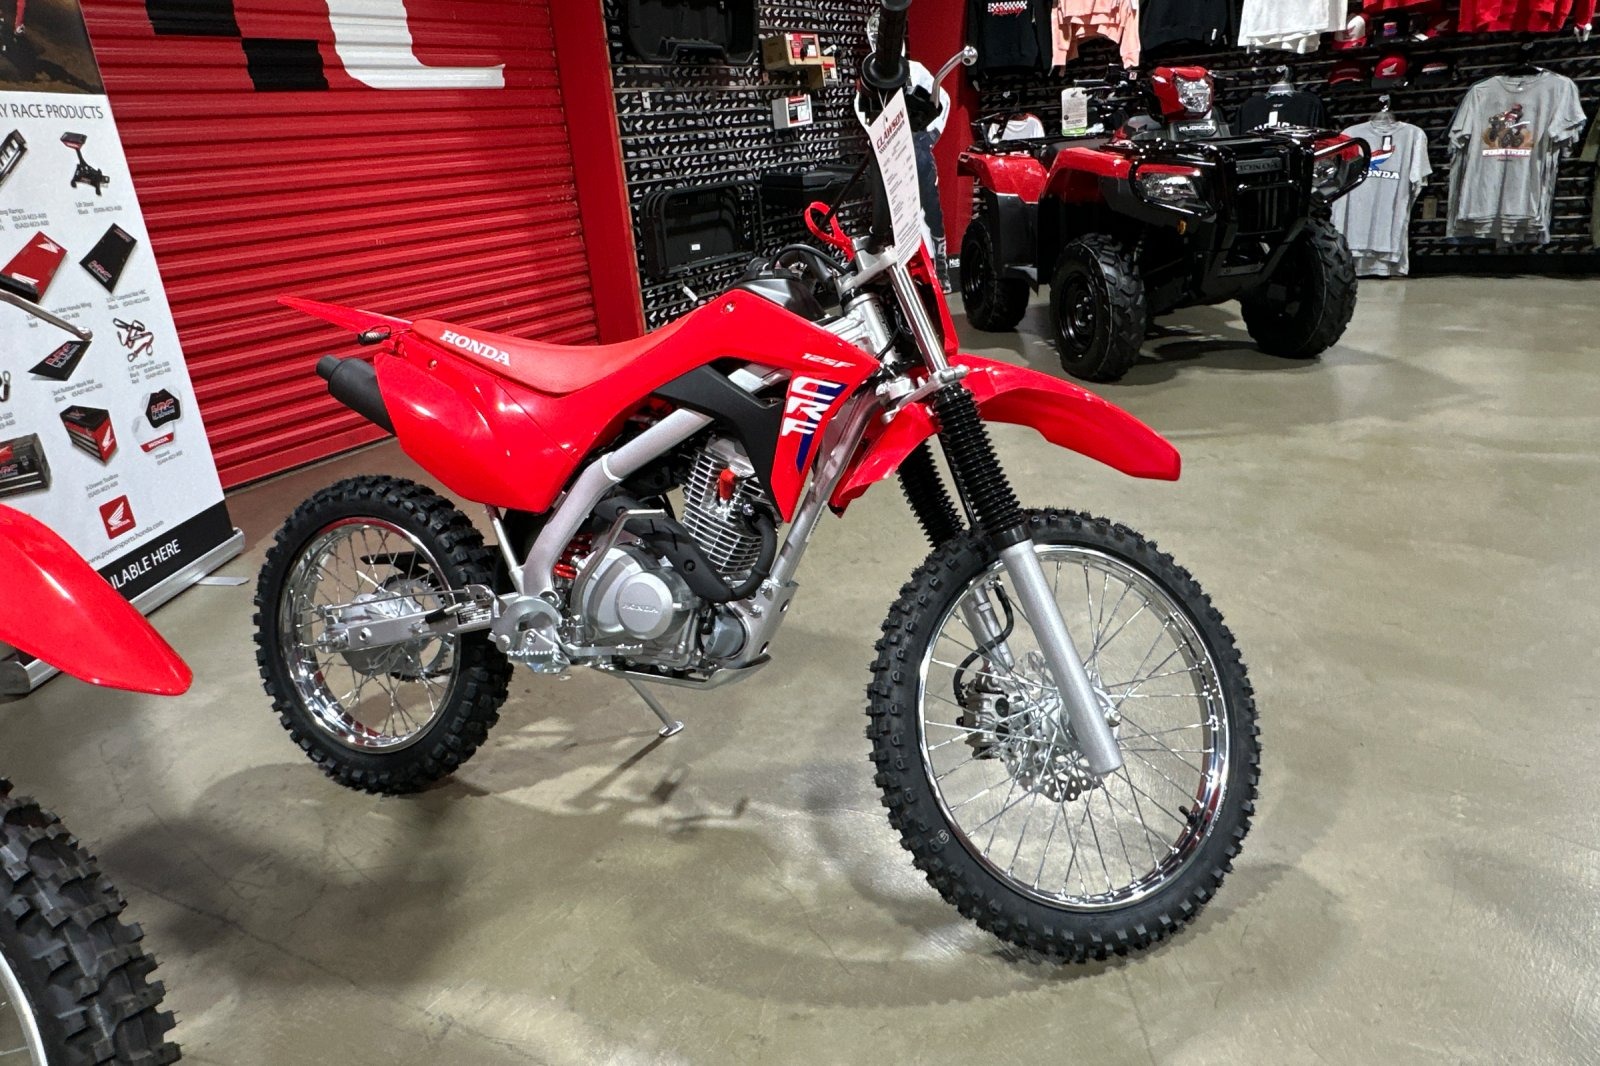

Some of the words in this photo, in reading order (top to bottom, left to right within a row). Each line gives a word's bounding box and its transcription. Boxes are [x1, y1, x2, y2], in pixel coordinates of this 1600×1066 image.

[10, 103, 45, 118] RACE
[45, 104, 104, 119] PRODUCTS
[1364, 170, 1400, 180] ONDA
[439, 330, 511, 367] HONDA
[802, 352, 856, 368] 125F
[781, 376, 842, 437] CRF
[109, 555, 153, 590] ILABLE
[150, 538, 182, 567] HERE
